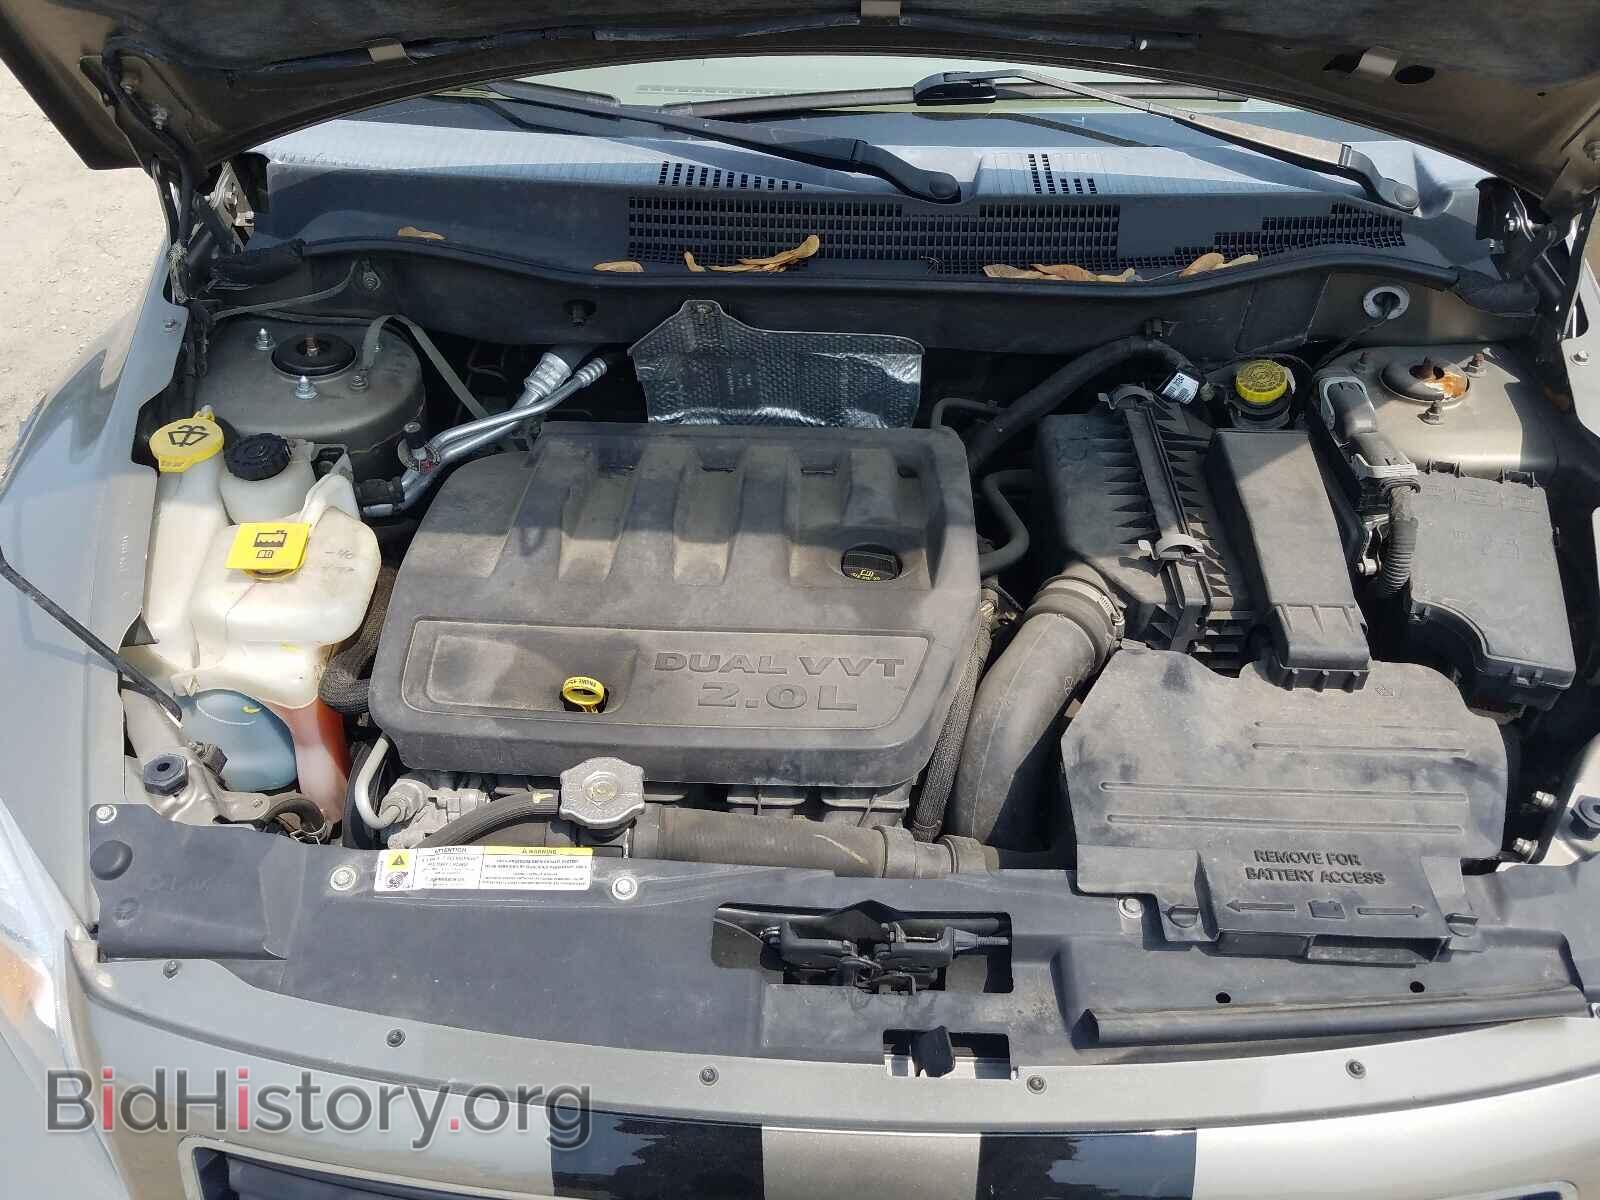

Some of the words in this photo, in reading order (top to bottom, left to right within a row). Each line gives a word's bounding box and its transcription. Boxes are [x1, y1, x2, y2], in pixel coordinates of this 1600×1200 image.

[654, 652, 788, 675] DUAL
[799, 656, 905, 677] VVT
[697, 682, 858, 712] 2.0L
[1254, 850, 1324, 865] REMOVE
[1326, 852, 1362, 866] FOR
[1245, 867, 1315, 882] BATTERY
[1320, 870, 1386, 885] ACCESS
